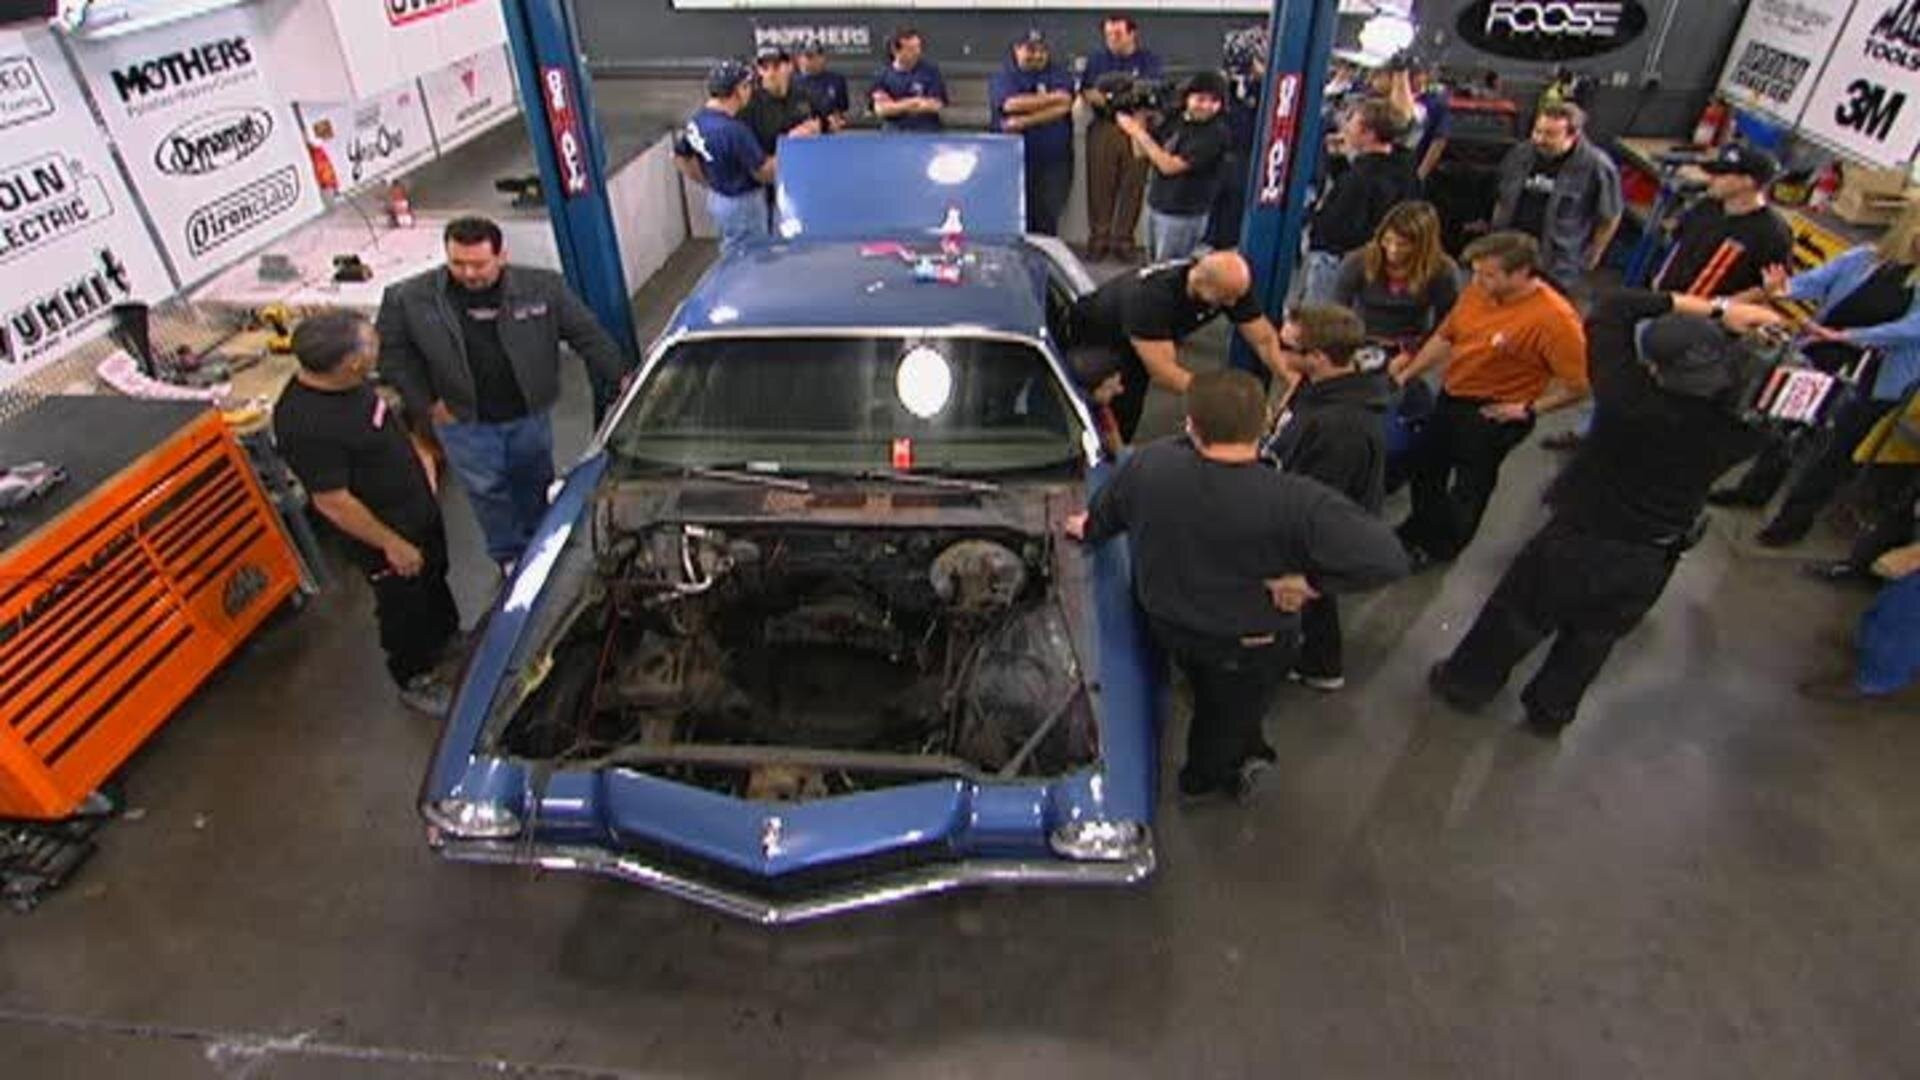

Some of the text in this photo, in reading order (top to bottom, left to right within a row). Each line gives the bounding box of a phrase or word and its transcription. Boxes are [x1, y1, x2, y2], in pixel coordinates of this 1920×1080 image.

[1485, 2, 1622, 37] FOOSE
[1870, 0, 1920, 48] MA
[111, 36, 252, 102] MOTHERS
[1864, 39, 1920, 71] TOOLS
[1835, 79, 1906, 141] 3M
[172, 115, 264, 172] Dynamat
